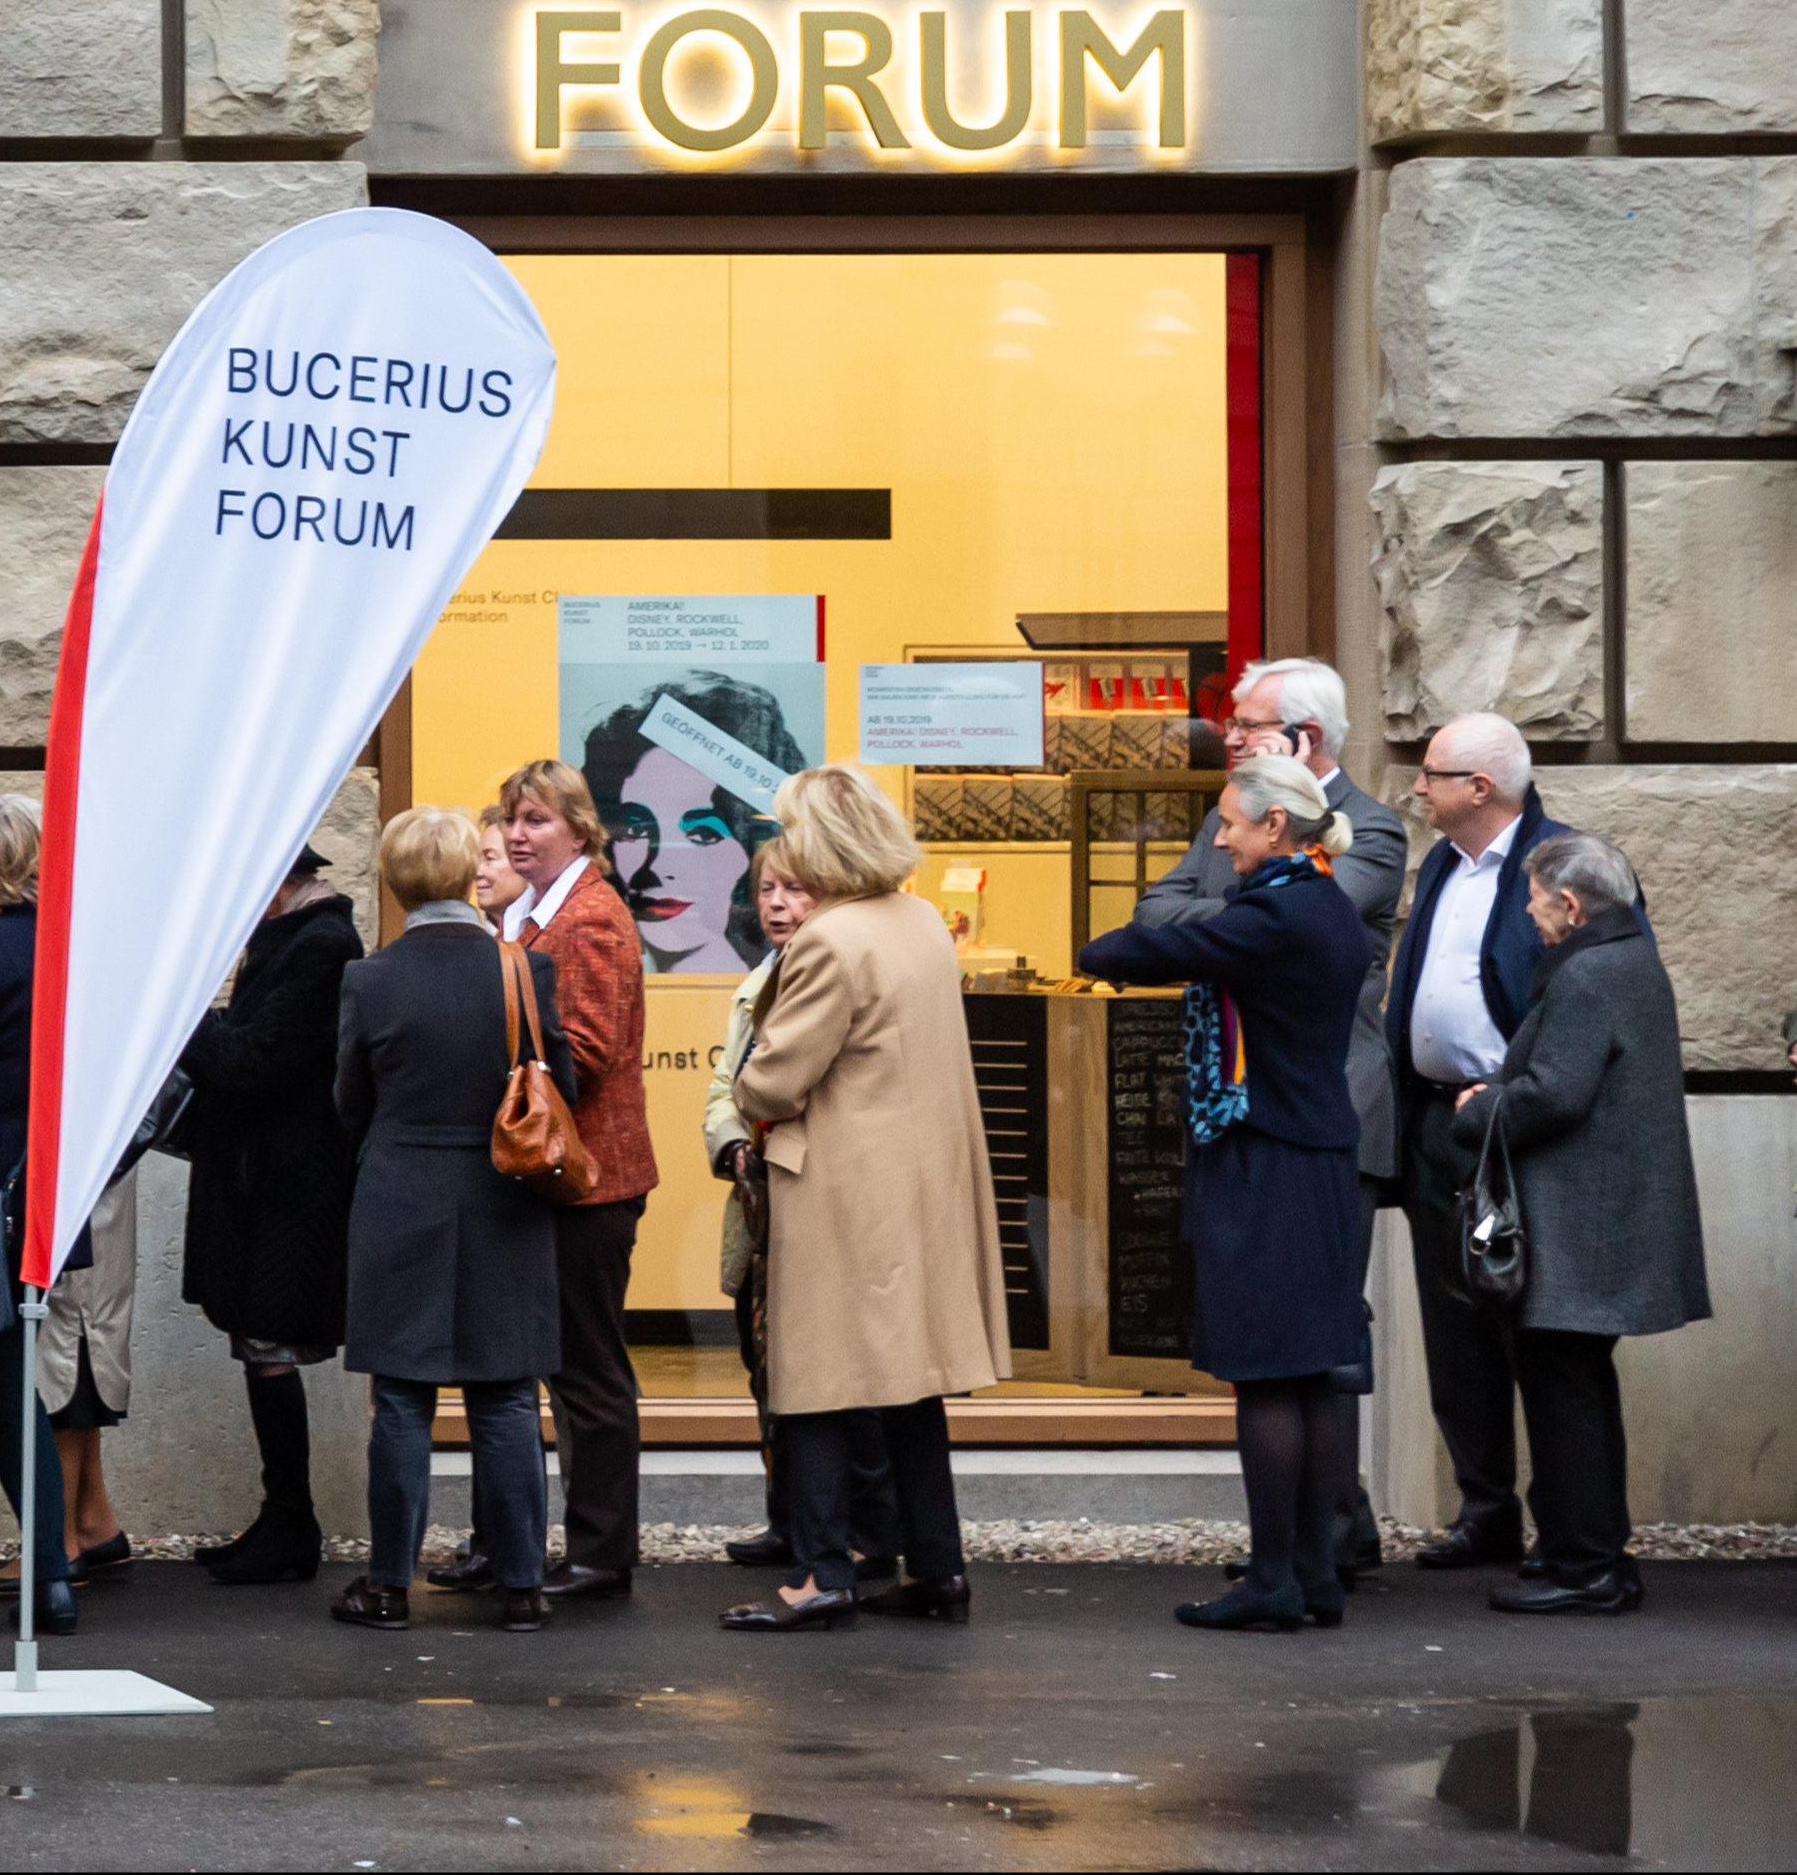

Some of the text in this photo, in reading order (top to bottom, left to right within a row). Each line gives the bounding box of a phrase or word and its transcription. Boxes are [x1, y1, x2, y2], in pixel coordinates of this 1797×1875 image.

[535, 8, 1185, 152] FORUM
[227, 347, 513, 418] BUCERIUS
[221, 418, 411, 478] KUNST
[215, 489, 415, 551] FORUM
[449, 591, 486, 604] erius
[491, 590, 536, 604] Kunst
[438, 611, 508, 623] ormation
[627, 614, 743, 625] DISNEY, ROCKWELL,
[627, 627, 739, 638] POLLOCK, WARHOL
[723, 754, 743, 769] AB
[642, 1045, 725, 1069] unst C
